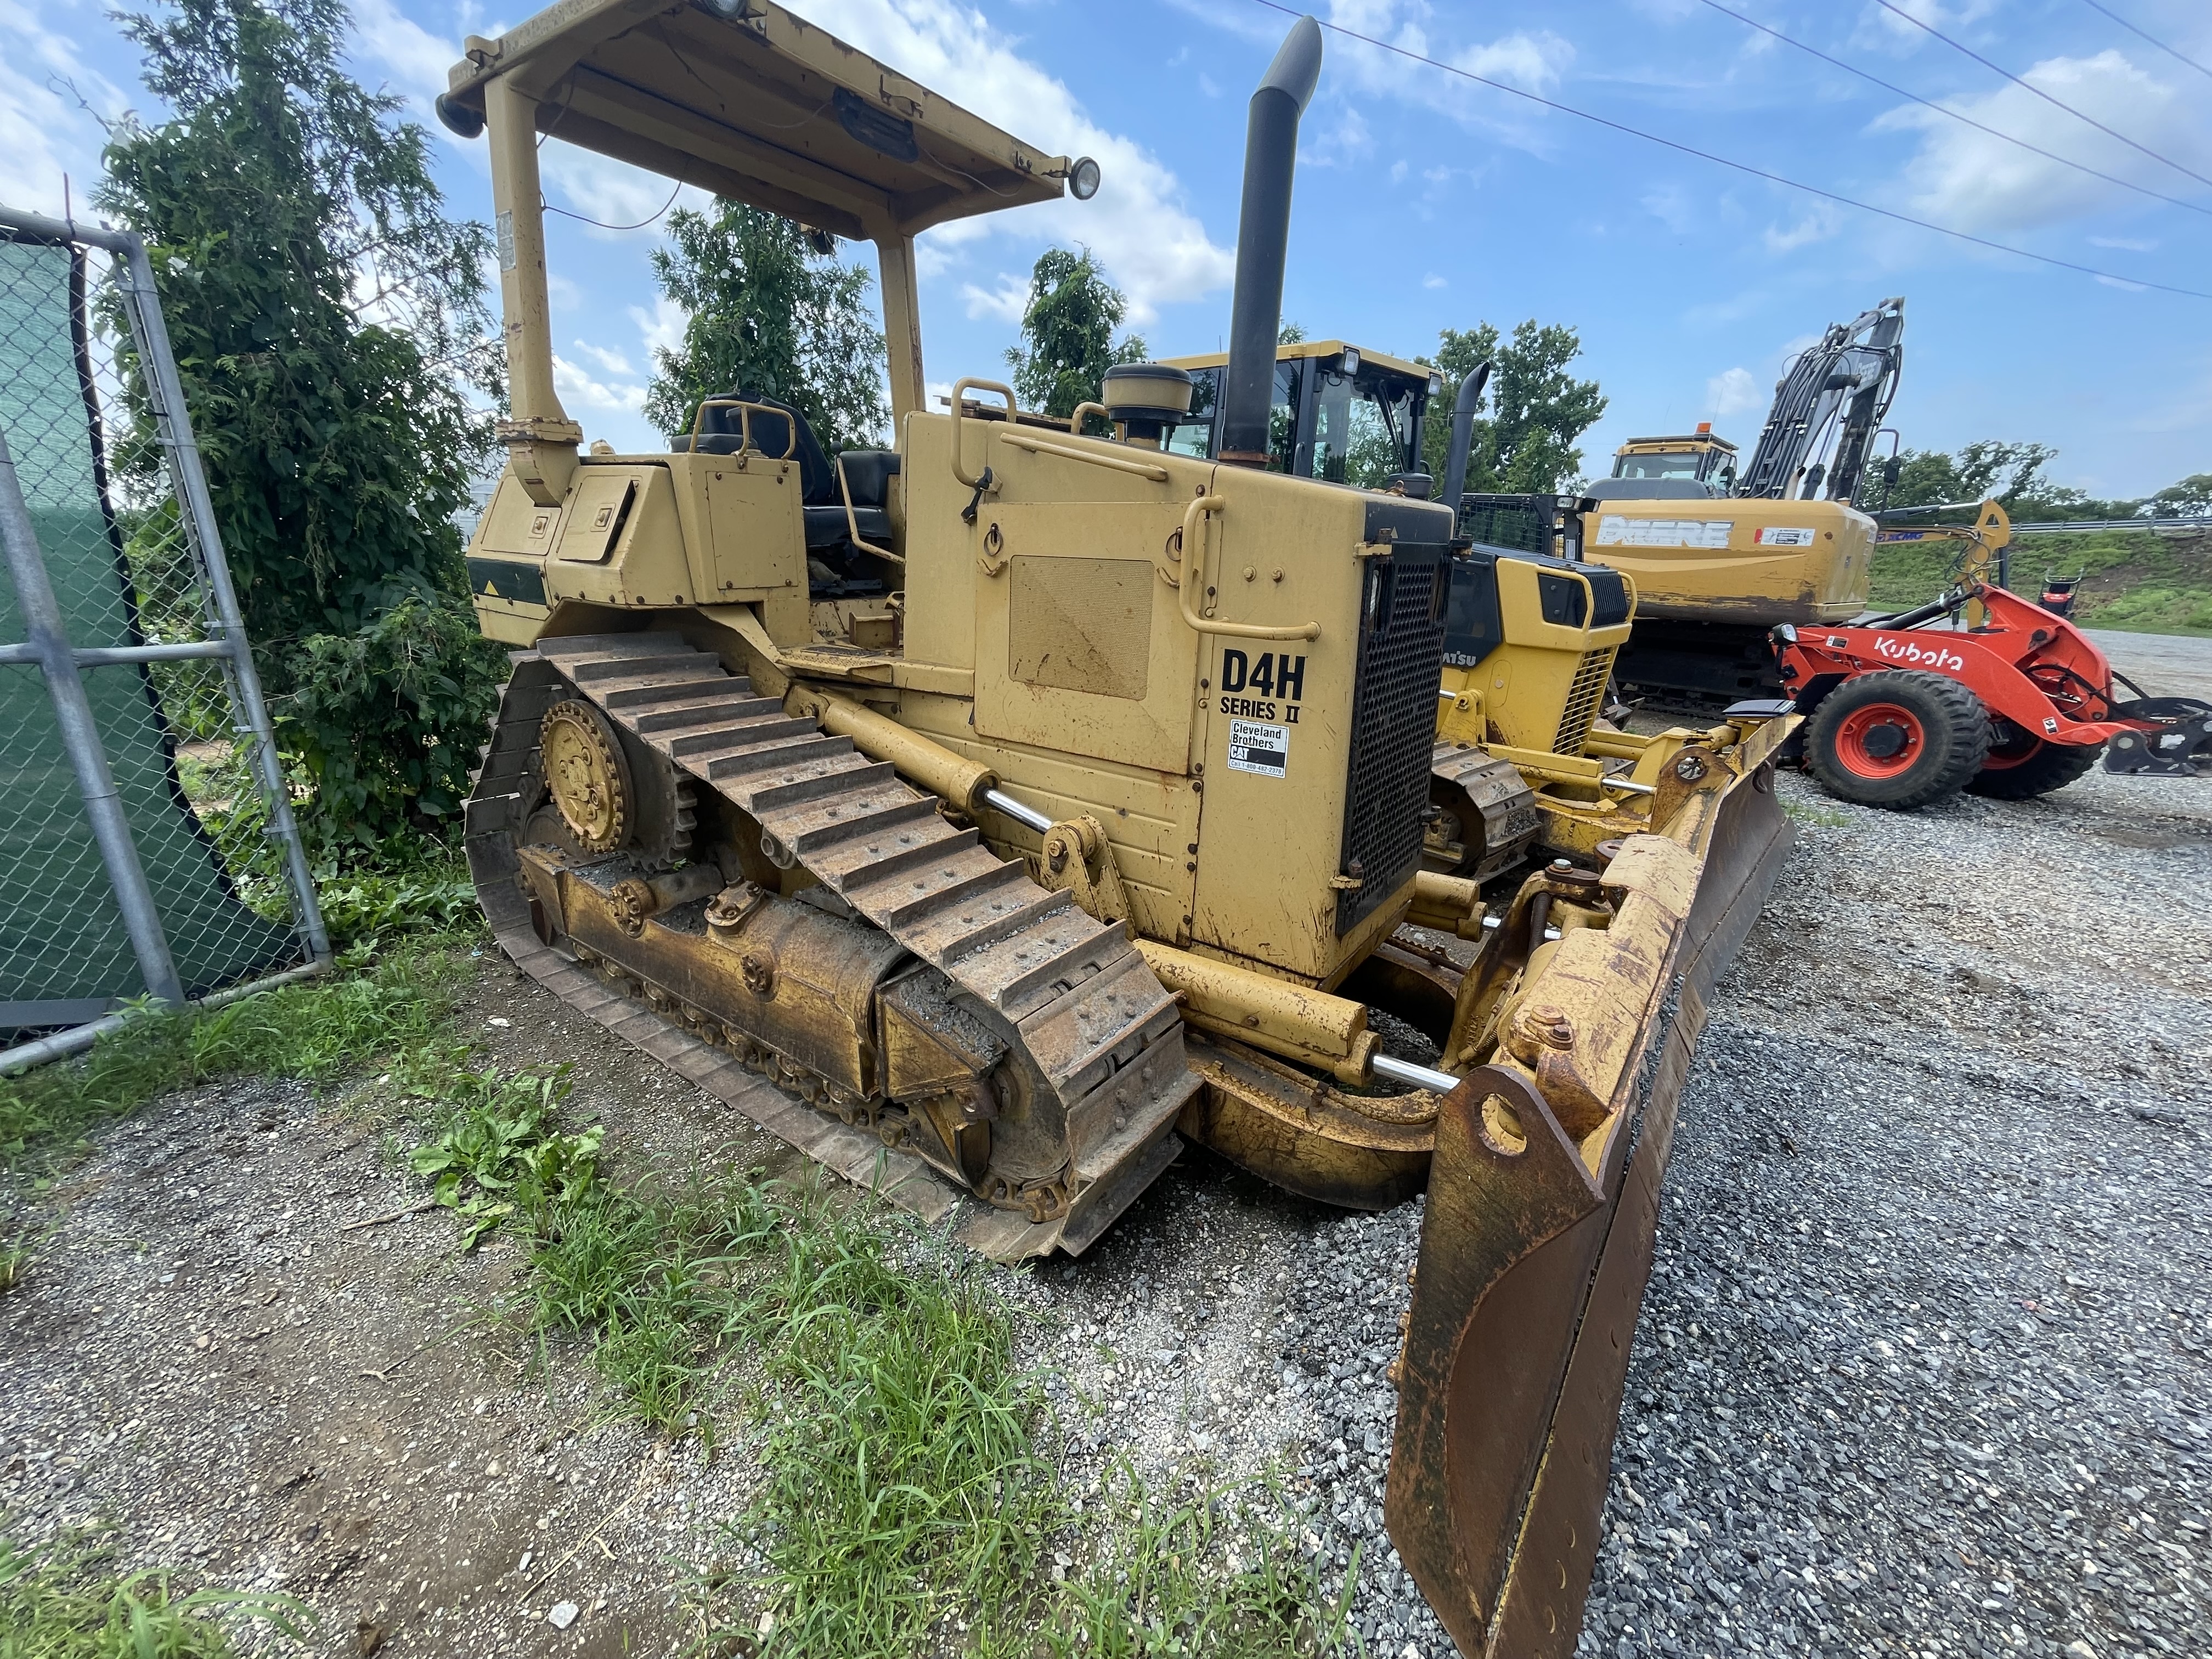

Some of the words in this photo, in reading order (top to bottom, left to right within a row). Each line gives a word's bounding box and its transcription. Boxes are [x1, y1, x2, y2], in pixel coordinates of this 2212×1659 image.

[1442, 651, 1476, 667] ATSU
[1874, 636, 1963, 671] Kubota
[1222, 648, 1306, 701] D4H
[1220, 697, 1276, 720] SERIES
[1233, 723, 1282, 739] Cleveland
[1233, 733, 1274, 749] Brothers
[1231, 746, 1249, 760] CAT
